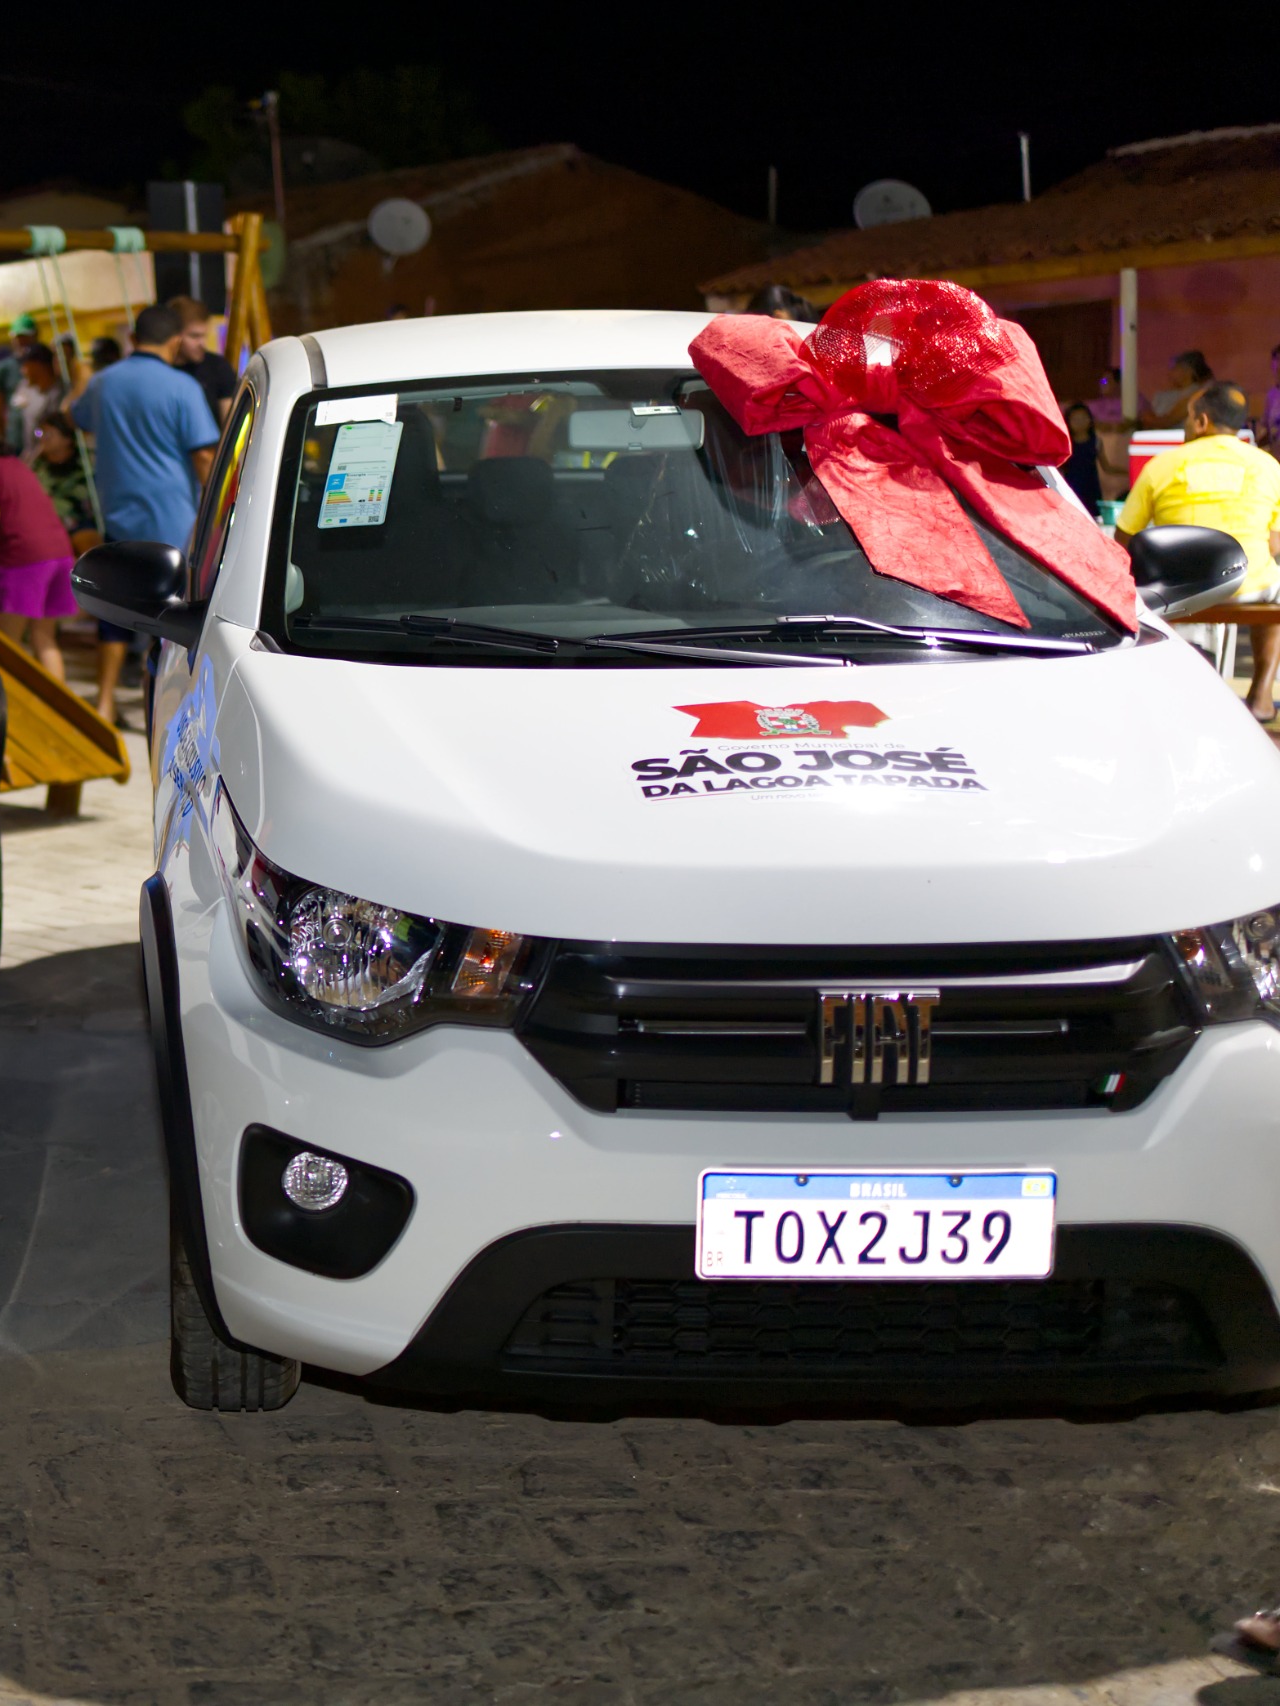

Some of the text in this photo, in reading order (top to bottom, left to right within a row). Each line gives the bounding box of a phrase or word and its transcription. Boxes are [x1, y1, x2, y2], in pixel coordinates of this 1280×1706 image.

[718, 741, 906, 751] Governo Municipal de
[631, 746, 977, 782] SÃO JOSÉ
[641, 772, 990, 799] DA LAGOA TAPADA
[818, 988, 940, 1084] FIAT
[848, 1181, 908, 1199] BRASIL
[733, 1210, 1013, 1265] TOX2J39
[706, 1250, 724, 1268] BR
